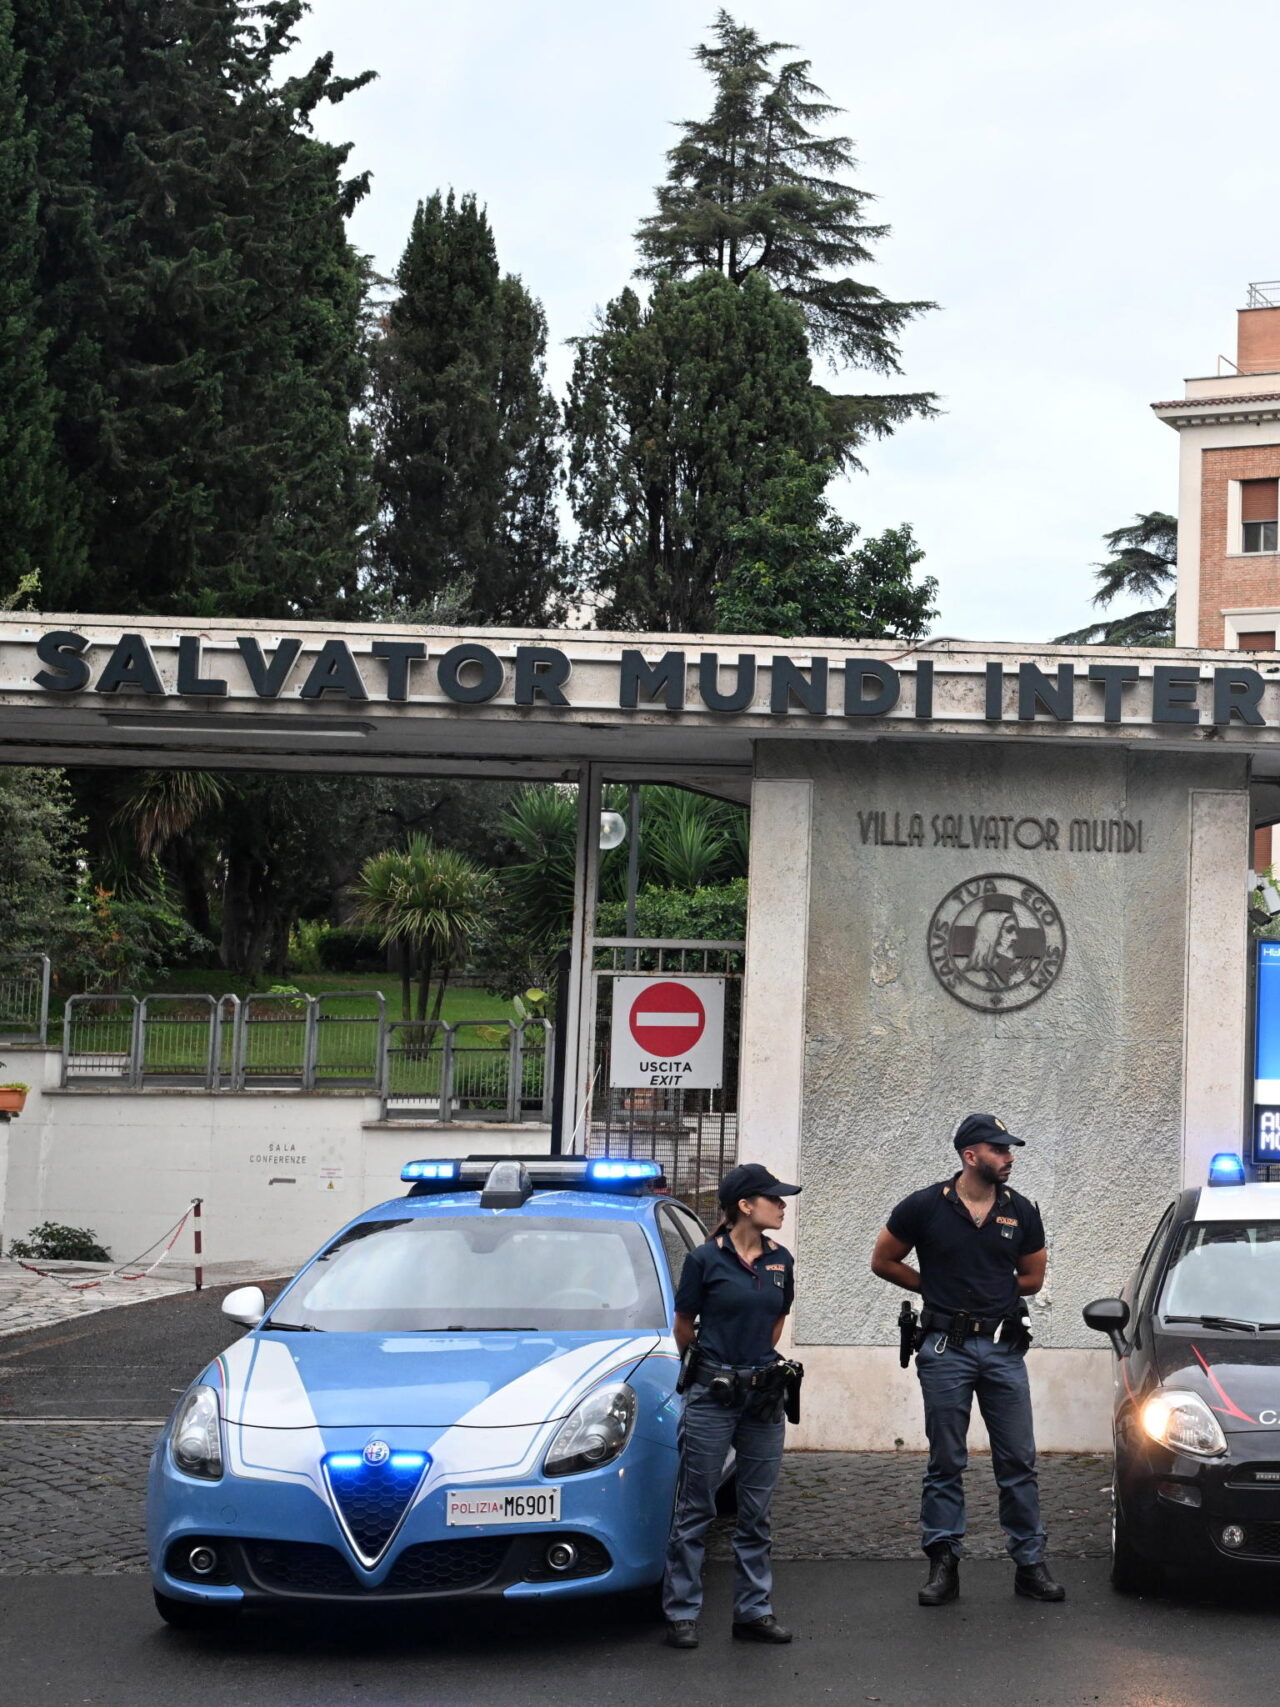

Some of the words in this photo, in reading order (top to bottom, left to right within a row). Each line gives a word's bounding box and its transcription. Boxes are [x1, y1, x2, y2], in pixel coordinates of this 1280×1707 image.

[33, 630, 572, 706] SALVATOR
[619, 649, 935, 718] MUNDI
[856, 811, 926, 848] VILLA
[931, 814, 1061, 851] SALVATOR
[1069, 818, 1144, 853] MUNDI
[640, 1061, 693, 1073] USCITA
[650, 1075, 683, 1086] EXIT
[268, 1143, 296, 1152] SALA
[249, 1154, 308, 1165] CONFERENZE
[450, 1502, 499, 1514] POLIZIA
[504, 1494, 554, 1517] M6901
